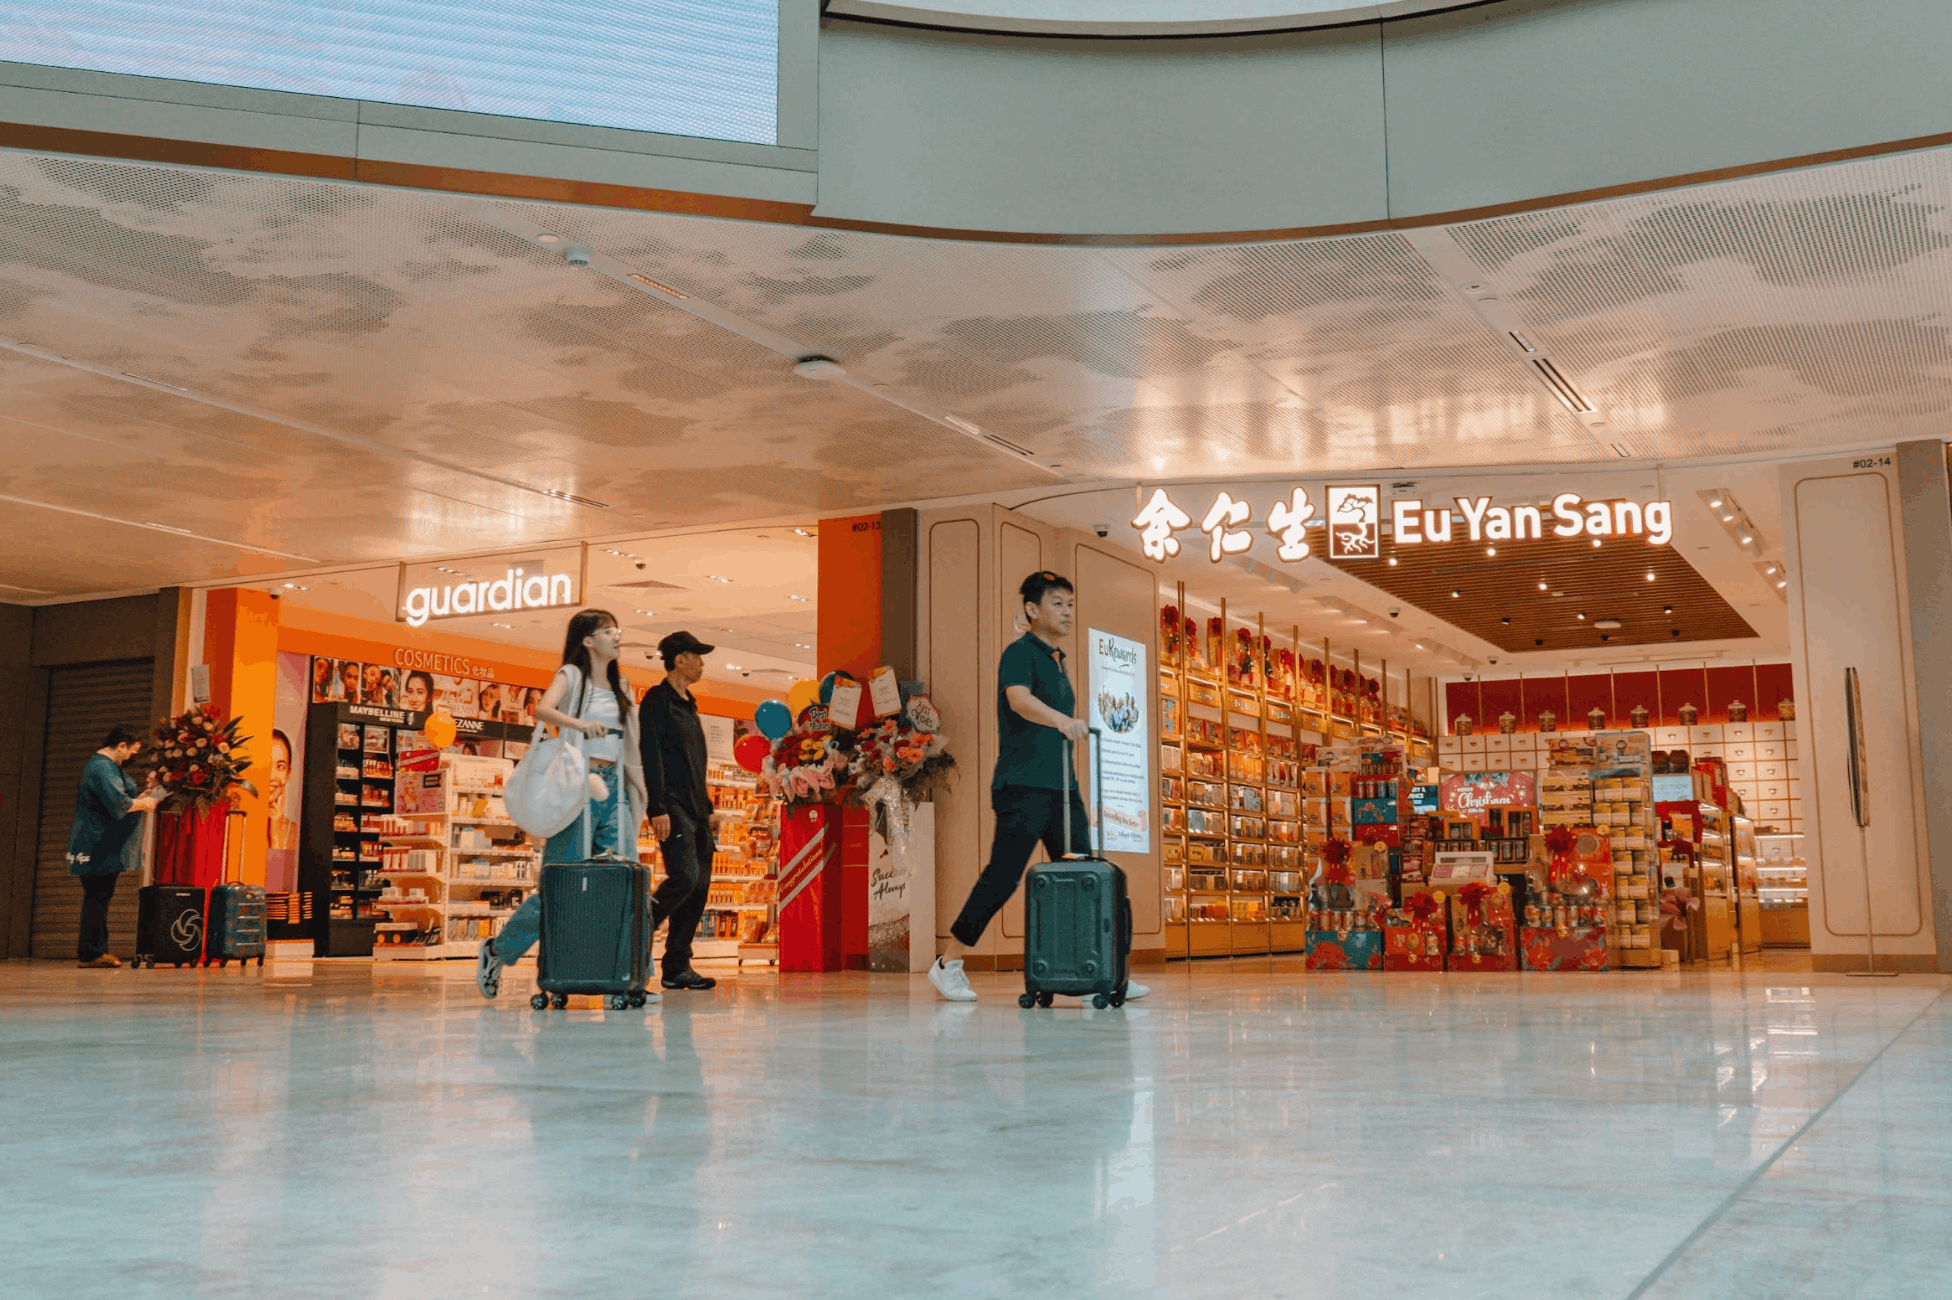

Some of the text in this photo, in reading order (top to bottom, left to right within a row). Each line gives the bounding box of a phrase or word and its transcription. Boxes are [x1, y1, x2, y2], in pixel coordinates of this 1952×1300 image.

[1853, 457, 1891, 469] #02-14
[852, 520, 881, 533] #02-13
[1131, 486, 1316, 563] 余仁生
[1393, 492, 1673, 546] Eu Yan Sang
[402, 568, 573, 627] guardian
[394, 647, 470, 677] COSMETICS
[349, 705, 405, 720] MAYBELLINE
[809, 706, 828, 719] Best
